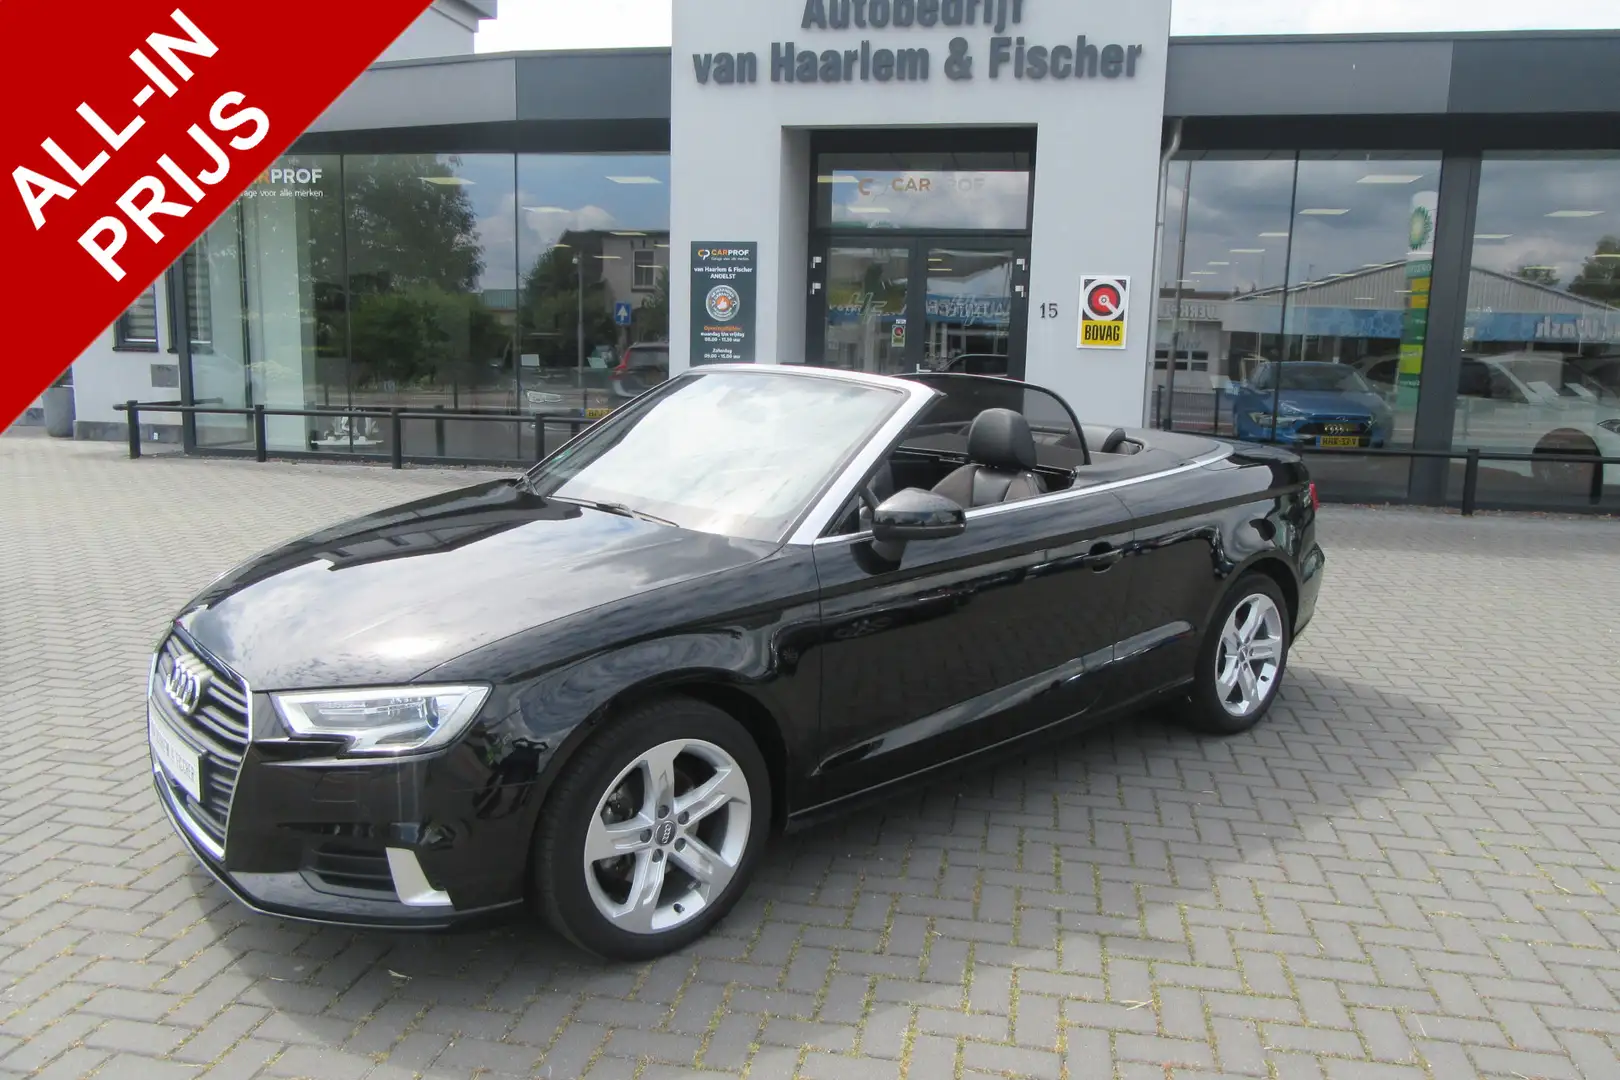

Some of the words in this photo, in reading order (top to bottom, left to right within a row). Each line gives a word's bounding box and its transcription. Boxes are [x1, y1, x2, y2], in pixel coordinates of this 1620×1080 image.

[801, 0, 1024, 32] Autobedrijf
[692, 52, 757, 85] van
[770, 40, 930, 83] Haarlem
[943, 37, 973, 80] &
[988, 35, 1143, 79] Fischer
[260, 189, 276, 197] voor
[280, 188, 292, 197] alle
[294, 188, 324, 197] merken
[1040, 302, 1058, 319] 15
[1084, 324, 1120, 341] BOVAG
